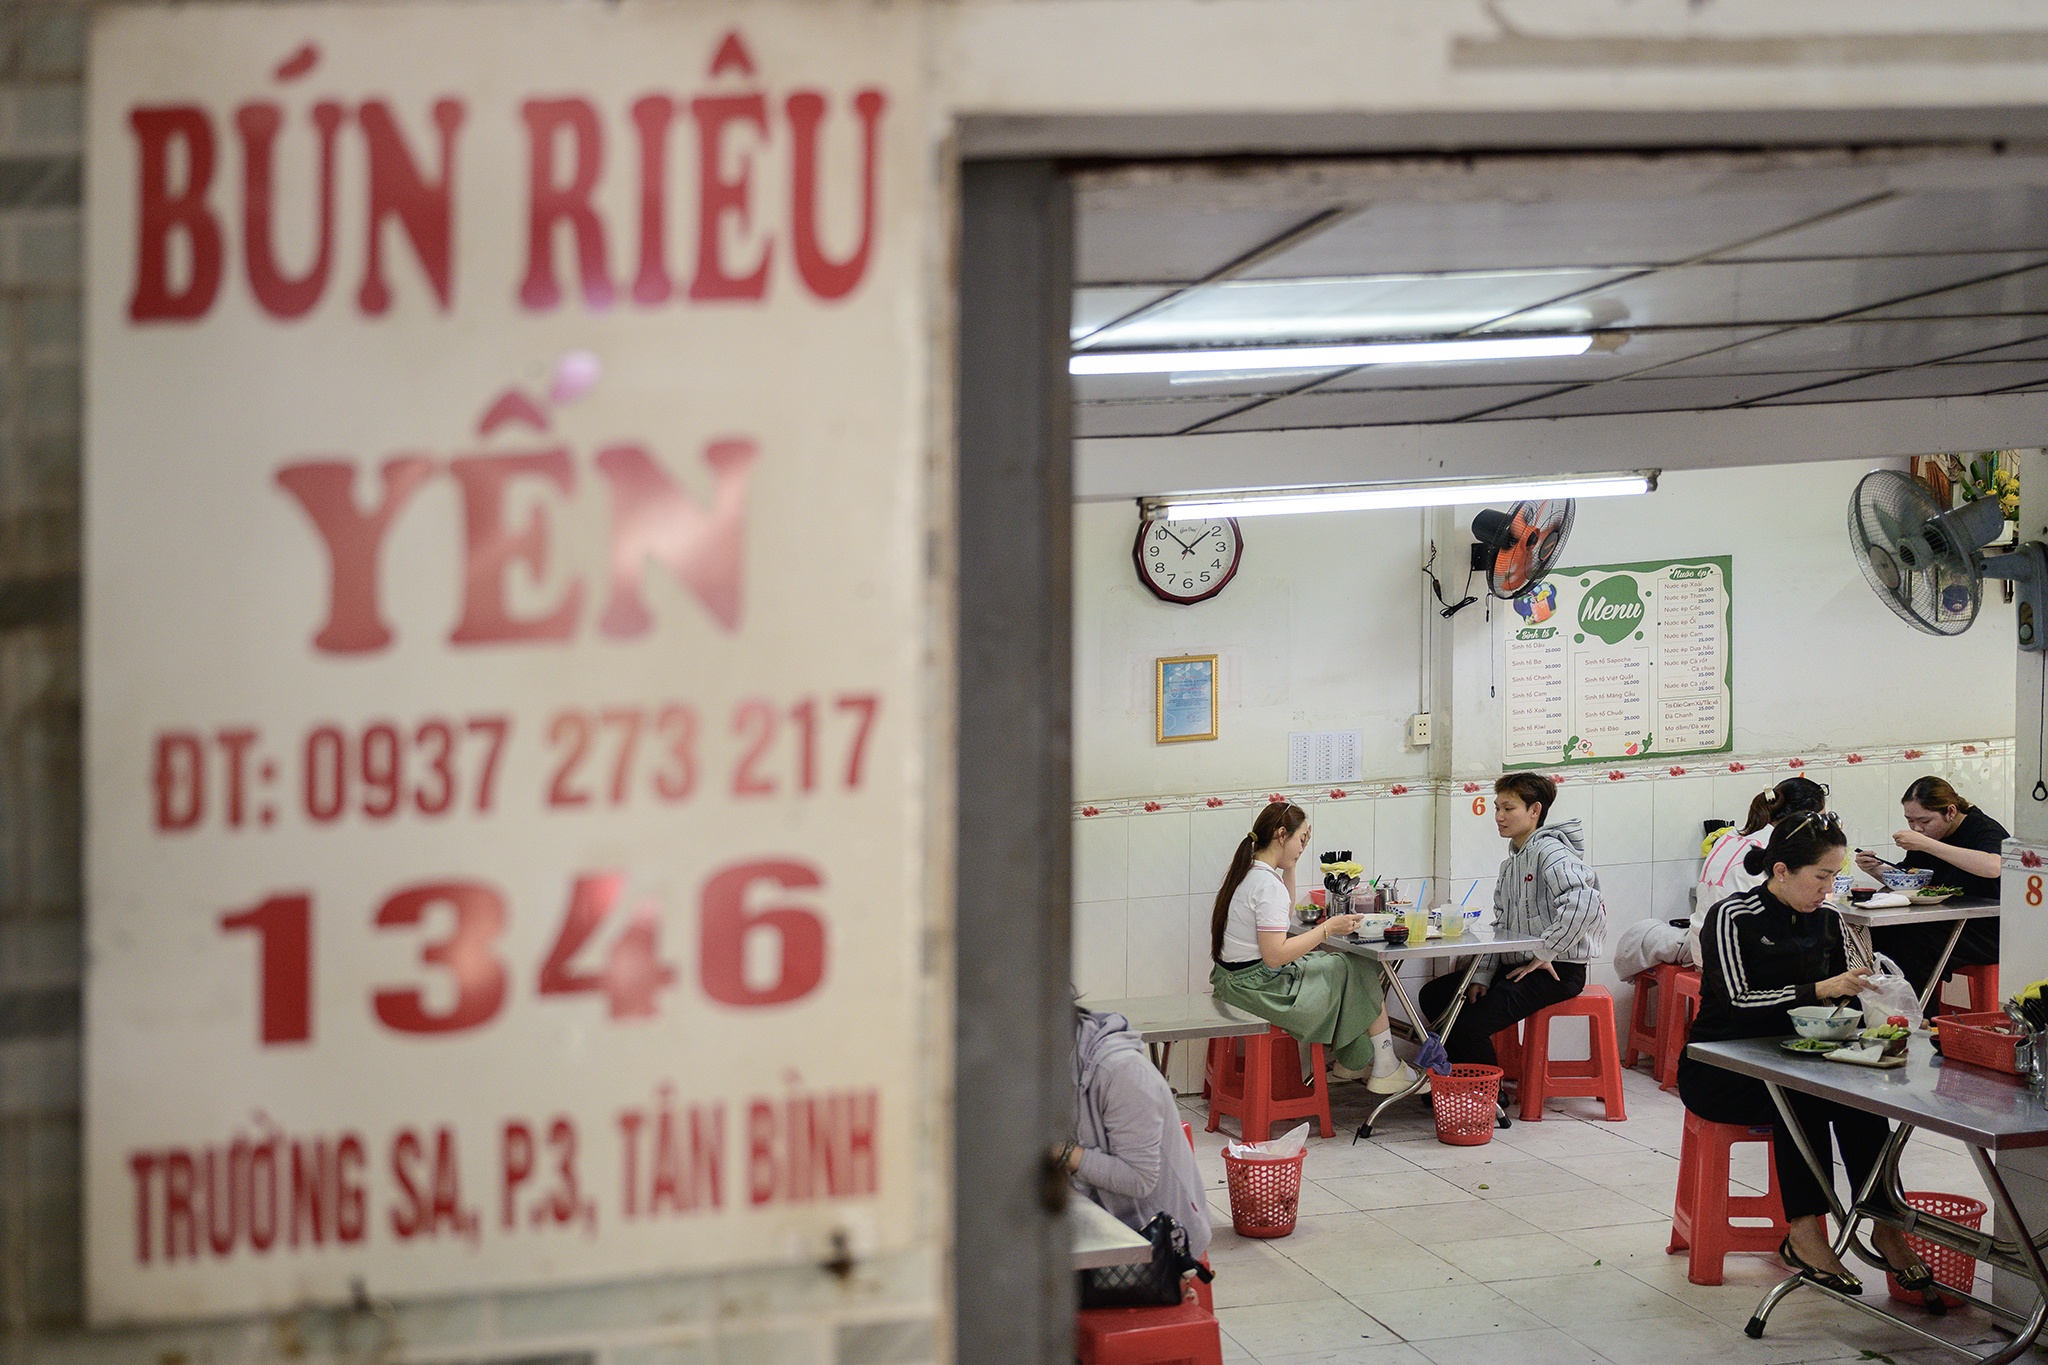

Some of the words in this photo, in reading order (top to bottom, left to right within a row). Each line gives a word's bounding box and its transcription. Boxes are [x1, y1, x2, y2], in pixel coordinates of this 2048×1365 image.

[127, 41, 468, 327] BÚN
[518, 27, 888, 311] RIÊU
[273, 350, 760, 658] YẾN
[1154, 530, 1168, 540] 10
[1211, 526, 1222, 536] 2
[1150, 546, 1160, 557] 9
[1215, 542, 1226, 552] 3
[1154, 562, 1165, 573] 8
[1210, 558, 1221, 569] 4
[1167, 574, 1176, 584] 7
[1200, 571, 1210, 582] 5
[1182, 578, 1194, 589] 6
[1581, 596, 1642, 624] Menu
[152, 730, 277, 832] ĐT:
[305, 715, 510, 825] 0937
[545, 704, 701, 809] 273
[729, 693, 883, 799] 217
[1472, 796, 1486, 816] 6
[2026, 874, 2043, 906] 8
[218, 859, 828, 1047] 1346
[128, 1110, 368, 1266] TRƯỜNG
[390, 1120, 481, 1248] SA,
[501, 1117, 598, 1240] P.3,
[617, 1082, 726, 1222] TÂN
[745, 1068, 881, 1210] BÌNH
